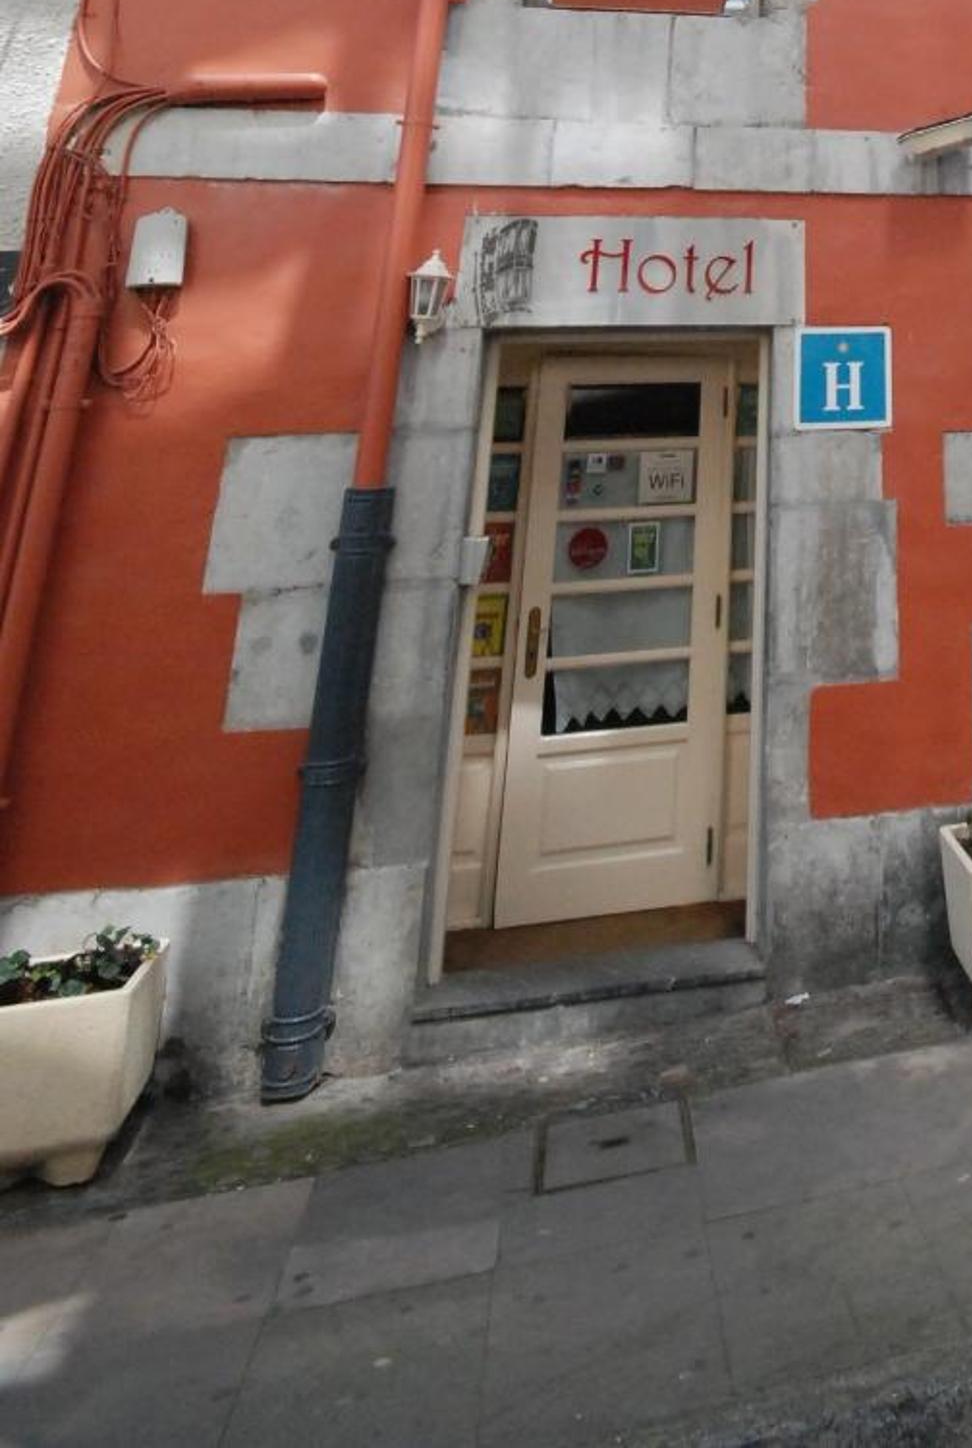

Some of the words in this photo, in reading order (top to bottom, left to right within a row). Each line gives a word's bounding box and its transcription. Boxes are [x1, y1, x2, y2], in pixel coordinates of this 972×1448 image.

[580, 238, 754, 300] Hotel
[821, 361, 865, 411] H
[648, 472, 685, 490] WiFi
